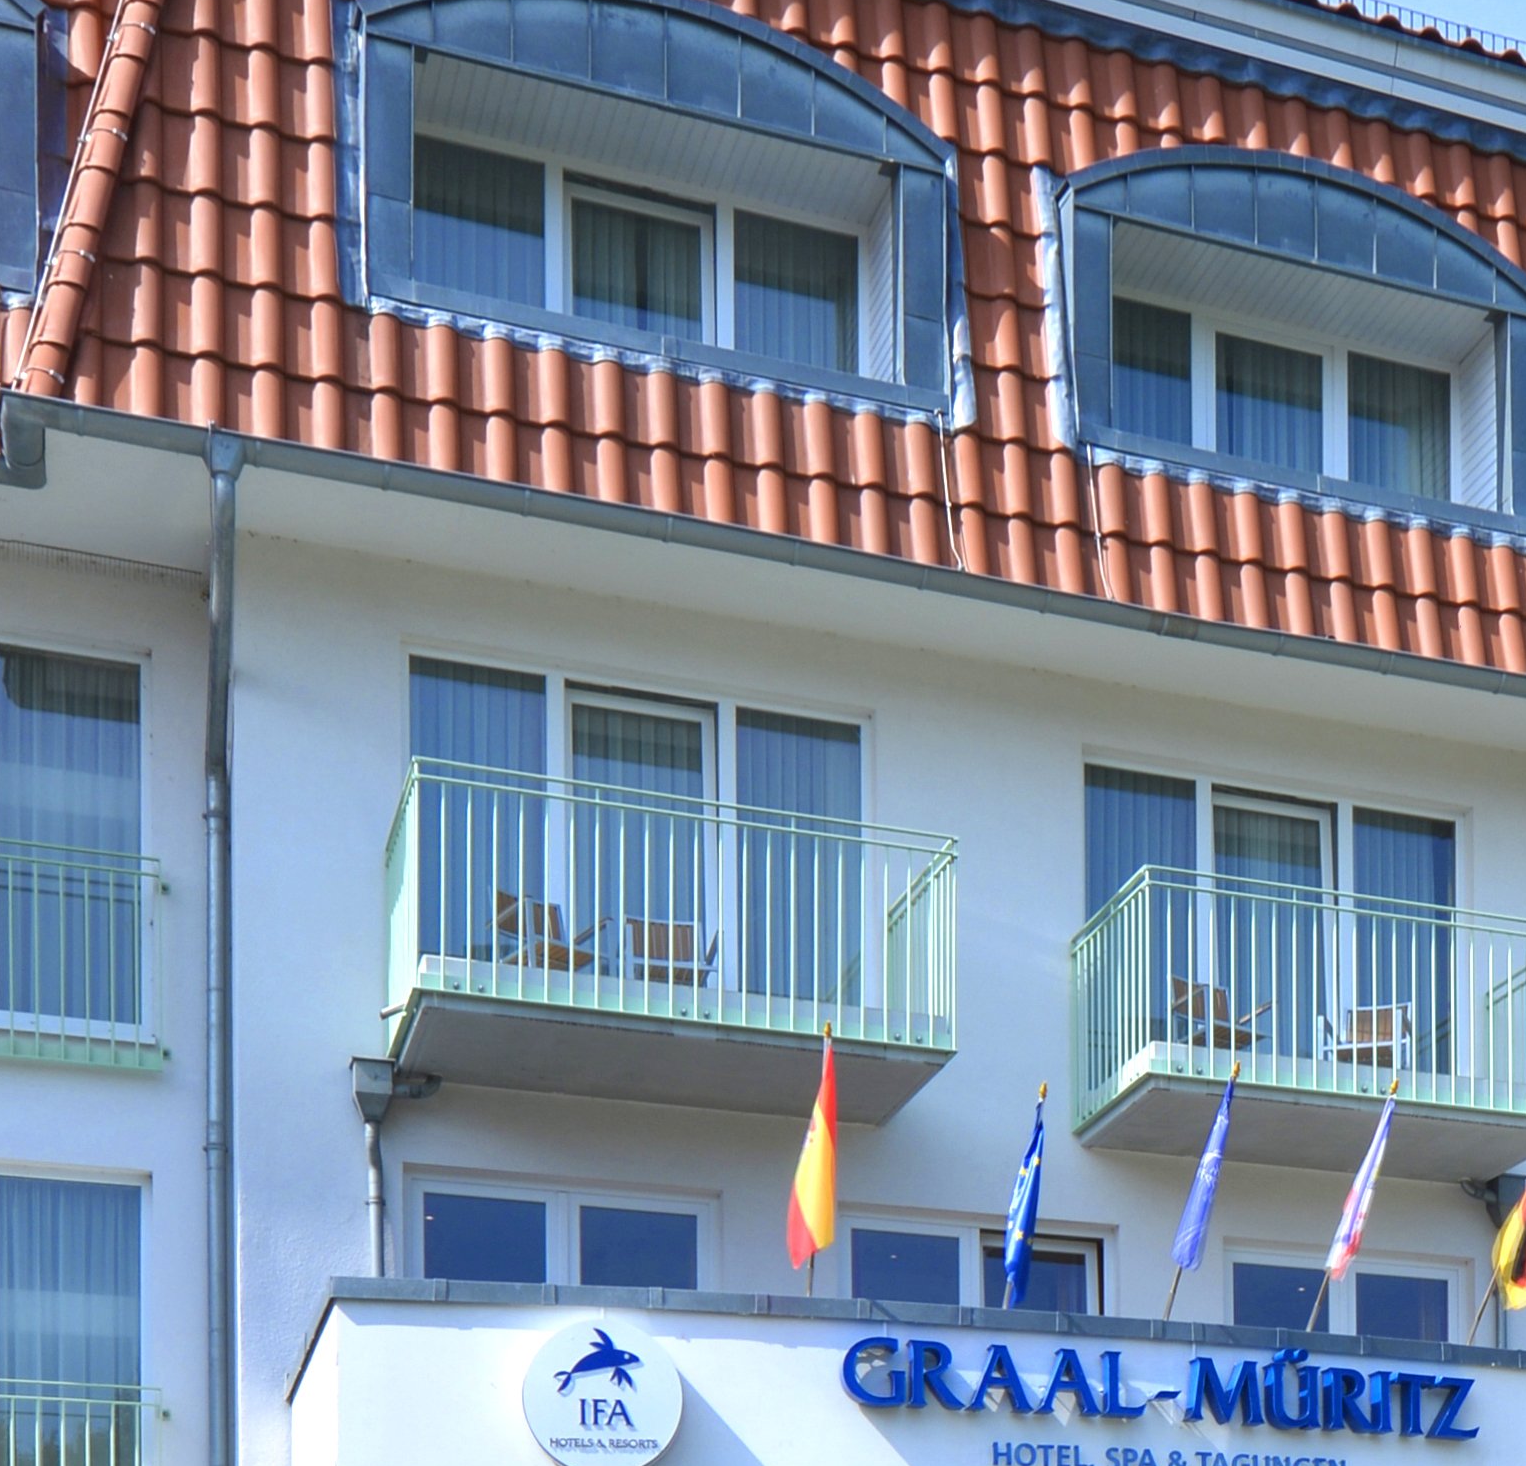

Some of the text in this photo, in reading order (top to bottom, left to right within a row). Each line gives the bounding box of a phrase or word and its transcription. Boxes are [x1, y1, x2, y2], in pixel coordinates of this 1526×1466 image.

[842, 1336, 1480, 1441] GRAAL-MÜRITZ
[579, 1398, 635, 1428] IFA
[549, 1437, 659, 1450] HOTELS & RESORTS
